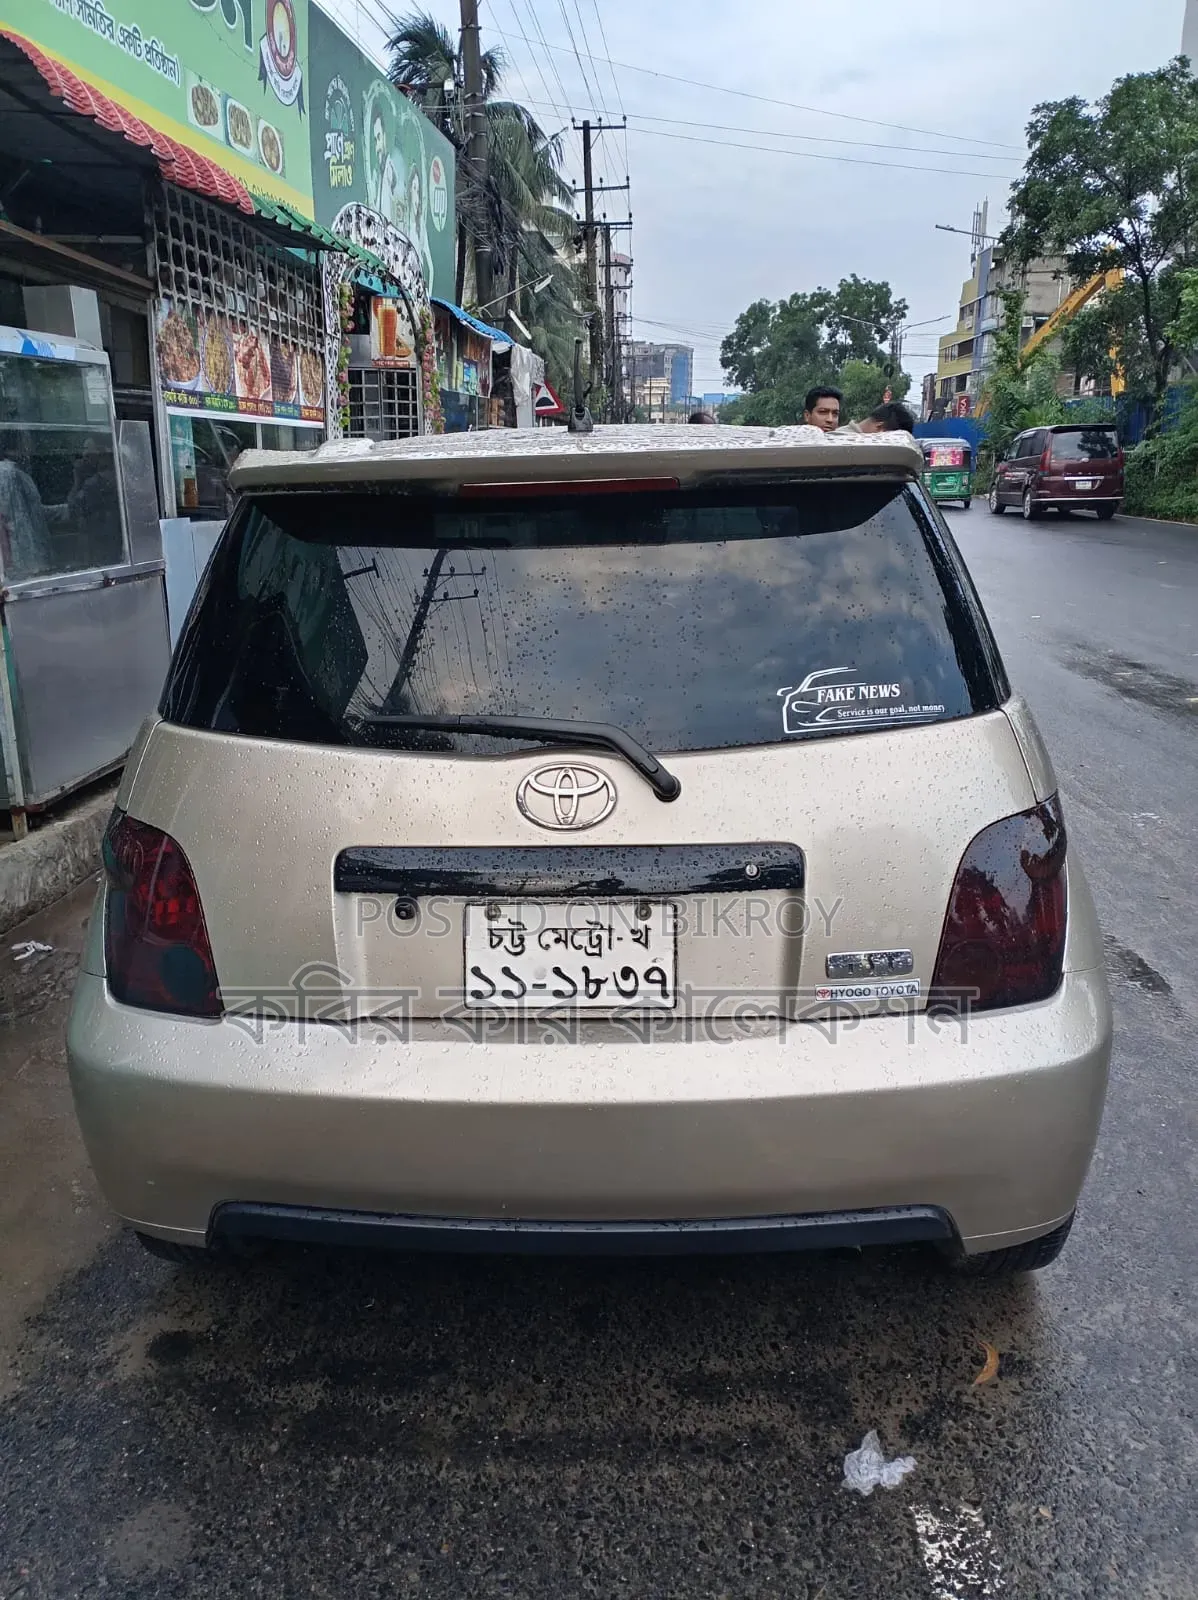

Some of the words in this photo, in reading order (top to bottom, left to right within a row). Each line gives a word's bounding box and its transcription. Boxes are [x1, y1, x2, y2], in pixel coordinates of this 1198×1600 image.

[118, 26, 142, 57] একটি
[817, 686, 856, 703] FAKE
[858, 683, 901, 700] NEWS
[837, 708, 865, 718] Service
[874, 707, 888, 715] our
[889, 704, 908, 716] goal,
[908, 704, 921, 712] not
[487, 918, 527, 956] চট্ট
[470, 965, 670, 1000] ১১-১৮৩৭
[830, 986, 871, 999] HYOGO
[874, 984, 918, 997] TOYOTA
